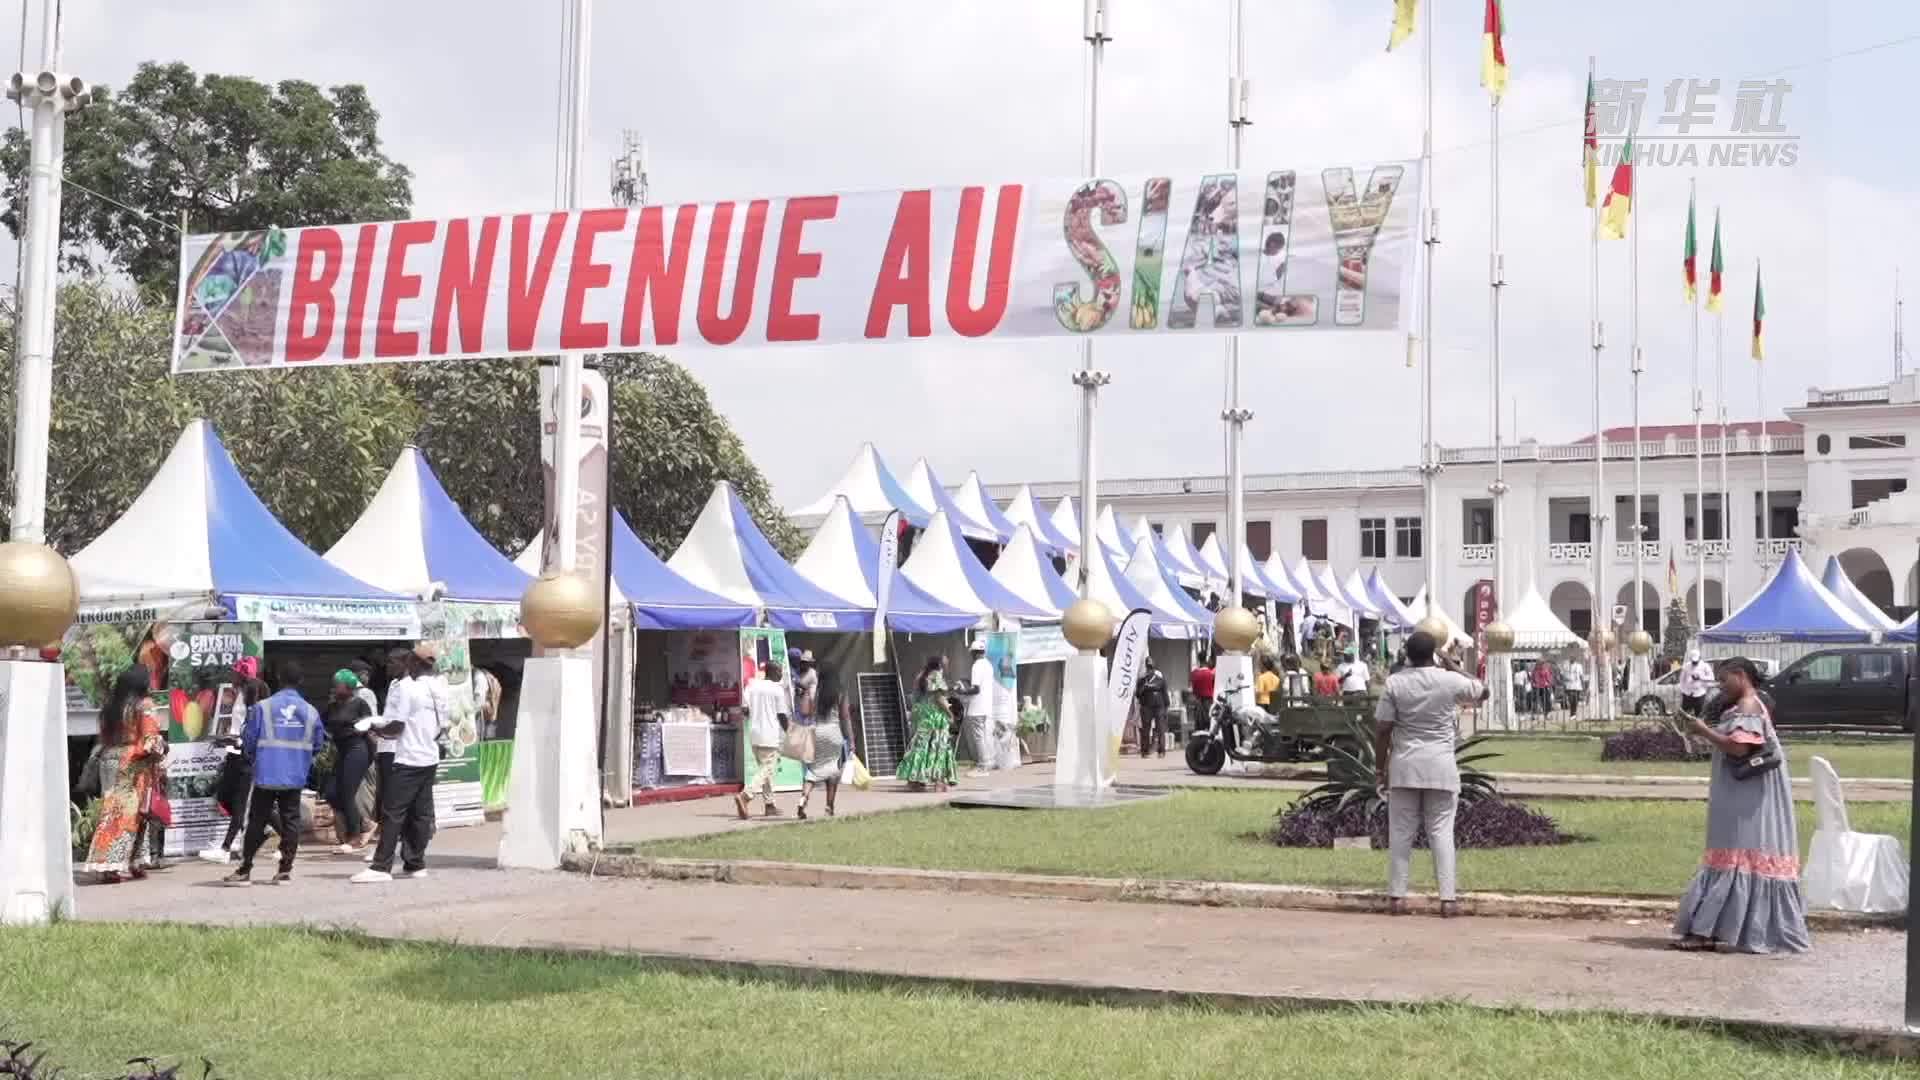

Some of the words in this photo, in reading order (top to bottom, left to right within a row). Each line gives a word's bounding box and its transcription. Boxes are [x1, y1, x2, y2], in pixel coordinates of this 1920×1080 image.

[284, 195, 839, 361] BIENVENUE
[864, 184, 1022, 338] AU
[1053, 165, 1404, 332] SIALY
[190, 634, 242, 647] CRYSTAL
